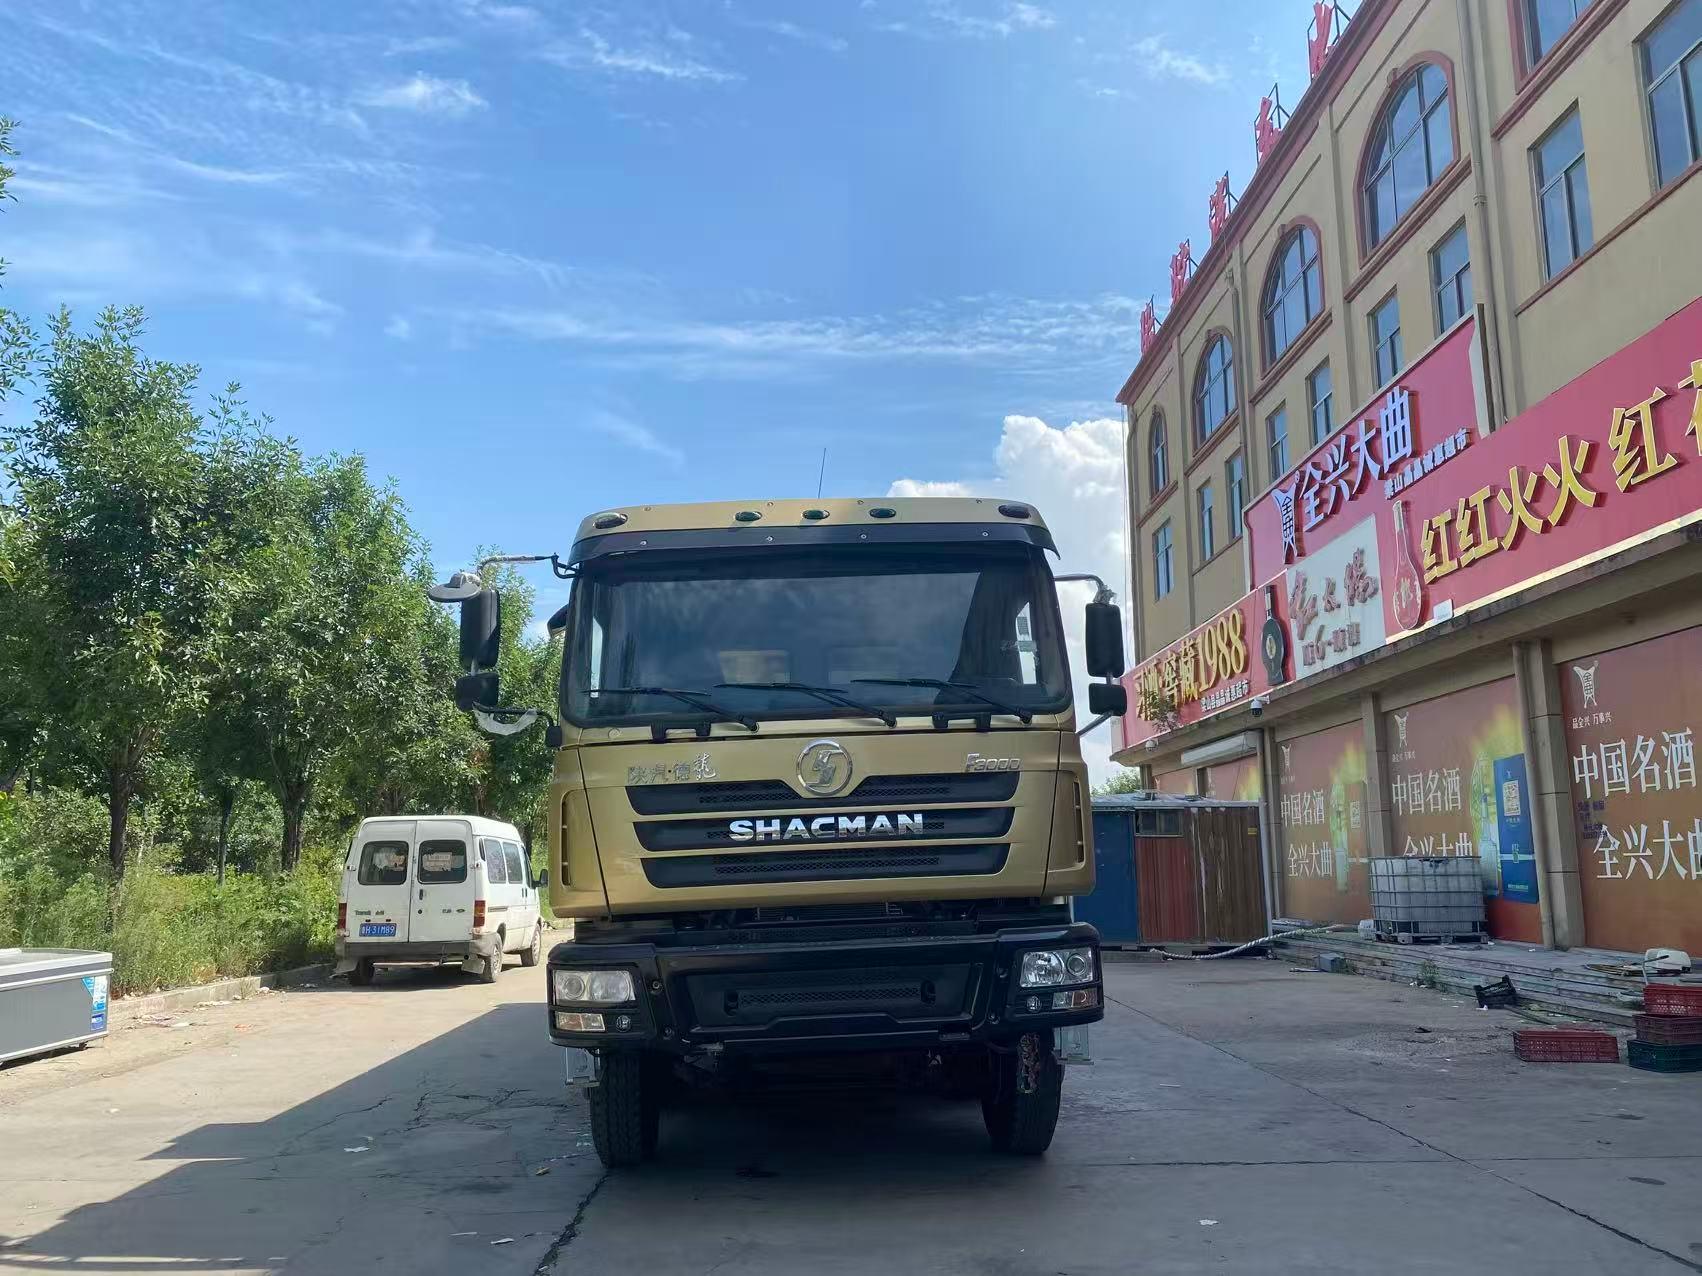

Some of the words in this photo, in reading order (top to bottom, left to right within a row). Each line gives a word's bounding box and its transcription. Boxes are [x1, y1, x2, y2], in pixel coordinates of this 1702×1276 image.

[1299, 386, 1413, 532] 全兴大曲
[1421, 434, 1597, 585] 红红火火
[1573, 727, 1697, 800] 中国名酒
[1280, 788, 1325, 828] 中国名酒
[1391, 767, 1462, 817] 中国名酒
[728, 813, 924, 842] SHACMAN
[1287, 841, 1333, 877] 全兴大曲
